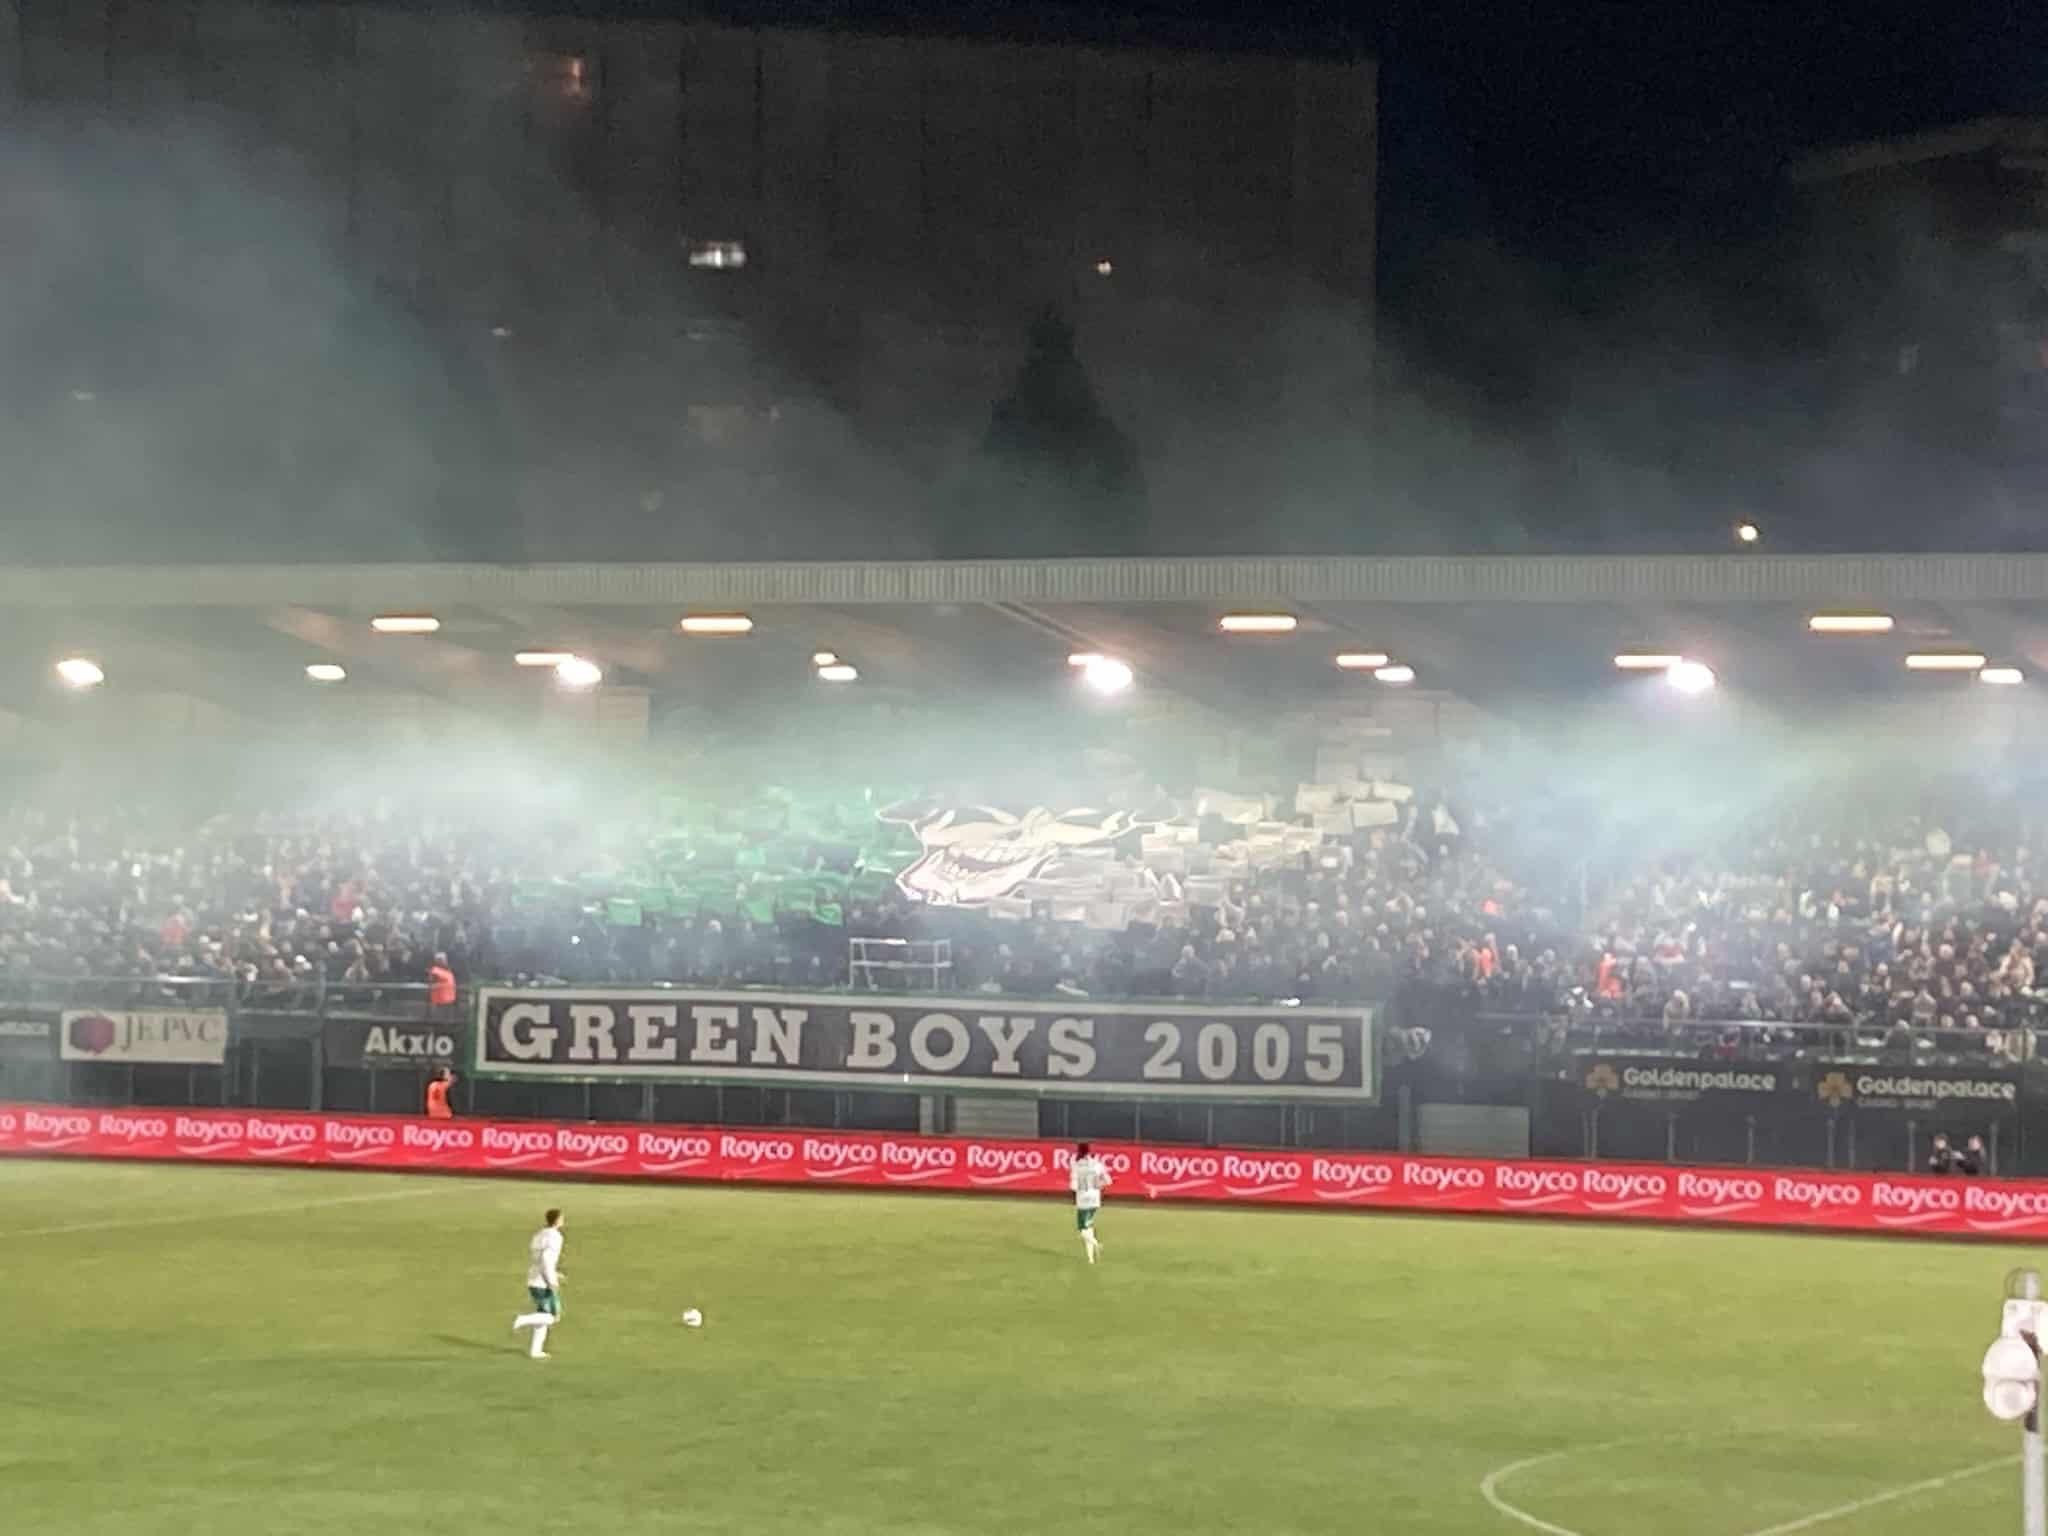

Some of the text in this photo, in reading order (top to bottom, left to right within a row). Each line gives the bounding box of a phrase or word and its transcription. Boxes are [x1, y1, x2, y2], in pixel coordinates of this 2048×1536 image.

[500, 1003, 1343, 1082] GREEN BOYS 2005
[1623, 1067, 1776, 1091] Goldenpalace
[1856, 1075, 2016, 1100] Goldenpalace
[24, 1112, 92, 1136] Royco
[99, 1114, 168, 1142] Royco
[175, 1117, 244, 1143] Royco
[247, 1119, 317, 1146] Royco
[324, 1122, 394, 1148] Royco
[403, 1124, 474, 1149] Royco
[481, 1128, 552, 1153] Royco
[557, 1130, 629, 1156] Royco
[638, 1133, 711, 1160] Royco
[720, 1136, 794, 1163] Royco
[803, 1139, 877, 1166] Royco
[881, 1142, 956, 1169] Royco
[967, 1145, 1043, 1172] Royco
[1140, 1151, 1218, 1178] Royco
[1223, 1155, 1300, 1183] Royco
[1312, 1159, 1392, 1187] Royco
[1403, 1162, 1485, 1190] Royco
[1496, 1166, 1578, 1194] Royco
[1583, 1170, 1666, 1199] Royco
[1678, 1174, 1763, 1204] Royco
[1774, 1178, 1860, 1208] Royco
[1872, 1182, 1959, 1213] Royco
